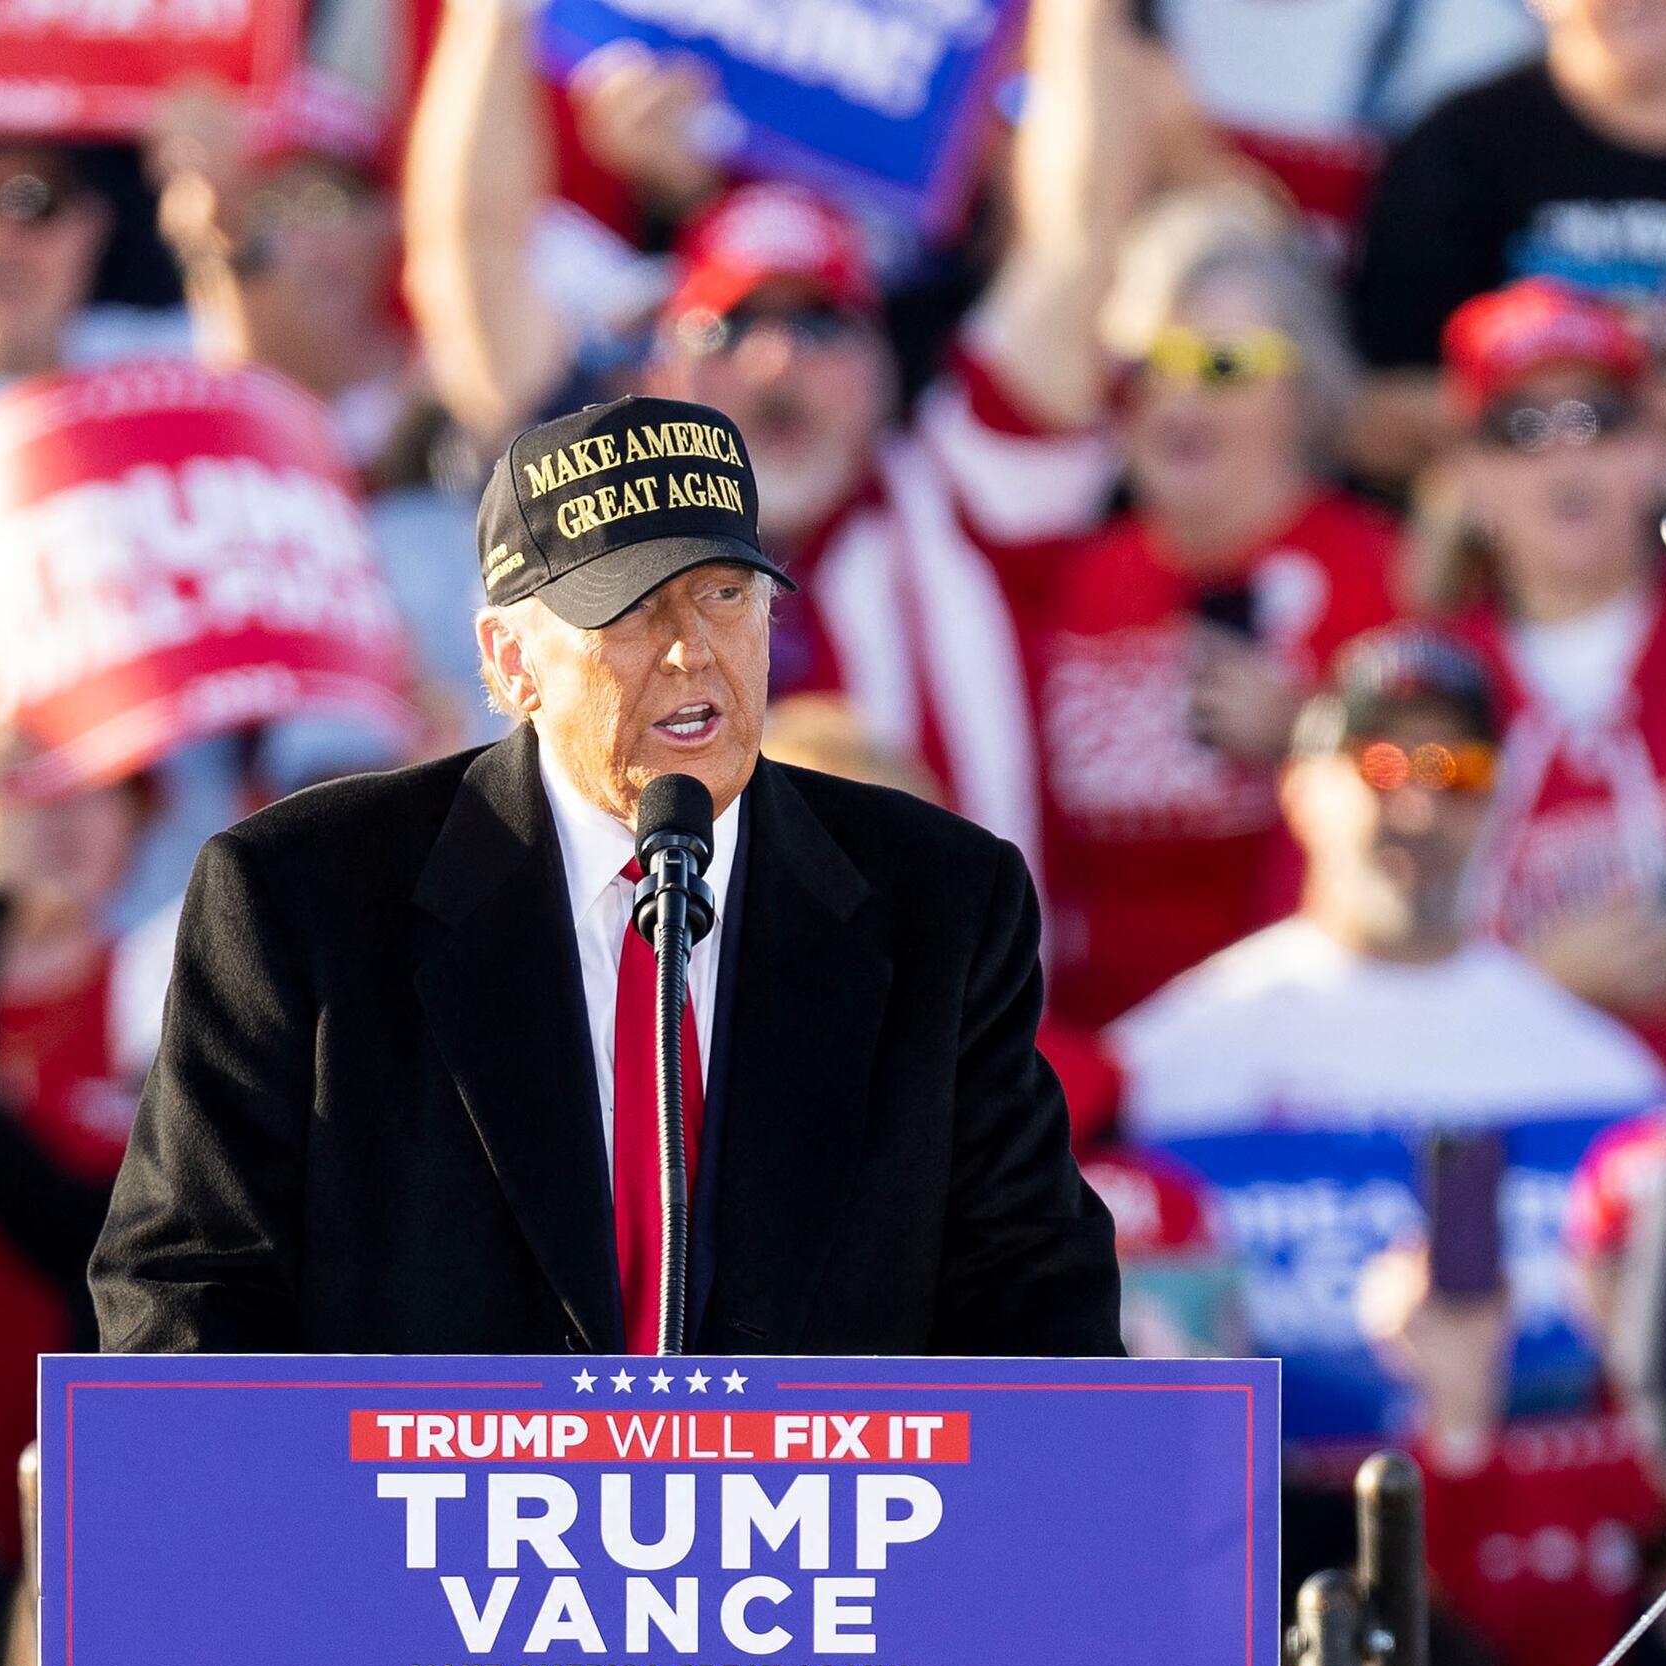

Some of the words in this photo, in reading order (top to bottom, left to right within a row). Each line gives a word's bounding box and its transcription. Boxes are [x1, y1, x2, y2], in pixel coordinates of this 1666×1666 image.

[524, 433, 622, 499] MAKE
[625, 421, 744, 469] AMERICA
[557, 476, 661, 540] GREAT
[668, 472, 744, 516] AGAIN
[377, 1415, 589, 1458] TRUMP
[606, 1415, 754, 1458] WILL
[774, 1415, 871, 1459] FIX
[888, 1416, 944, 1459] IT
[376, 1473, 944, 1571] TRUMP
[440, 1576, 877, 1655] VANCE
